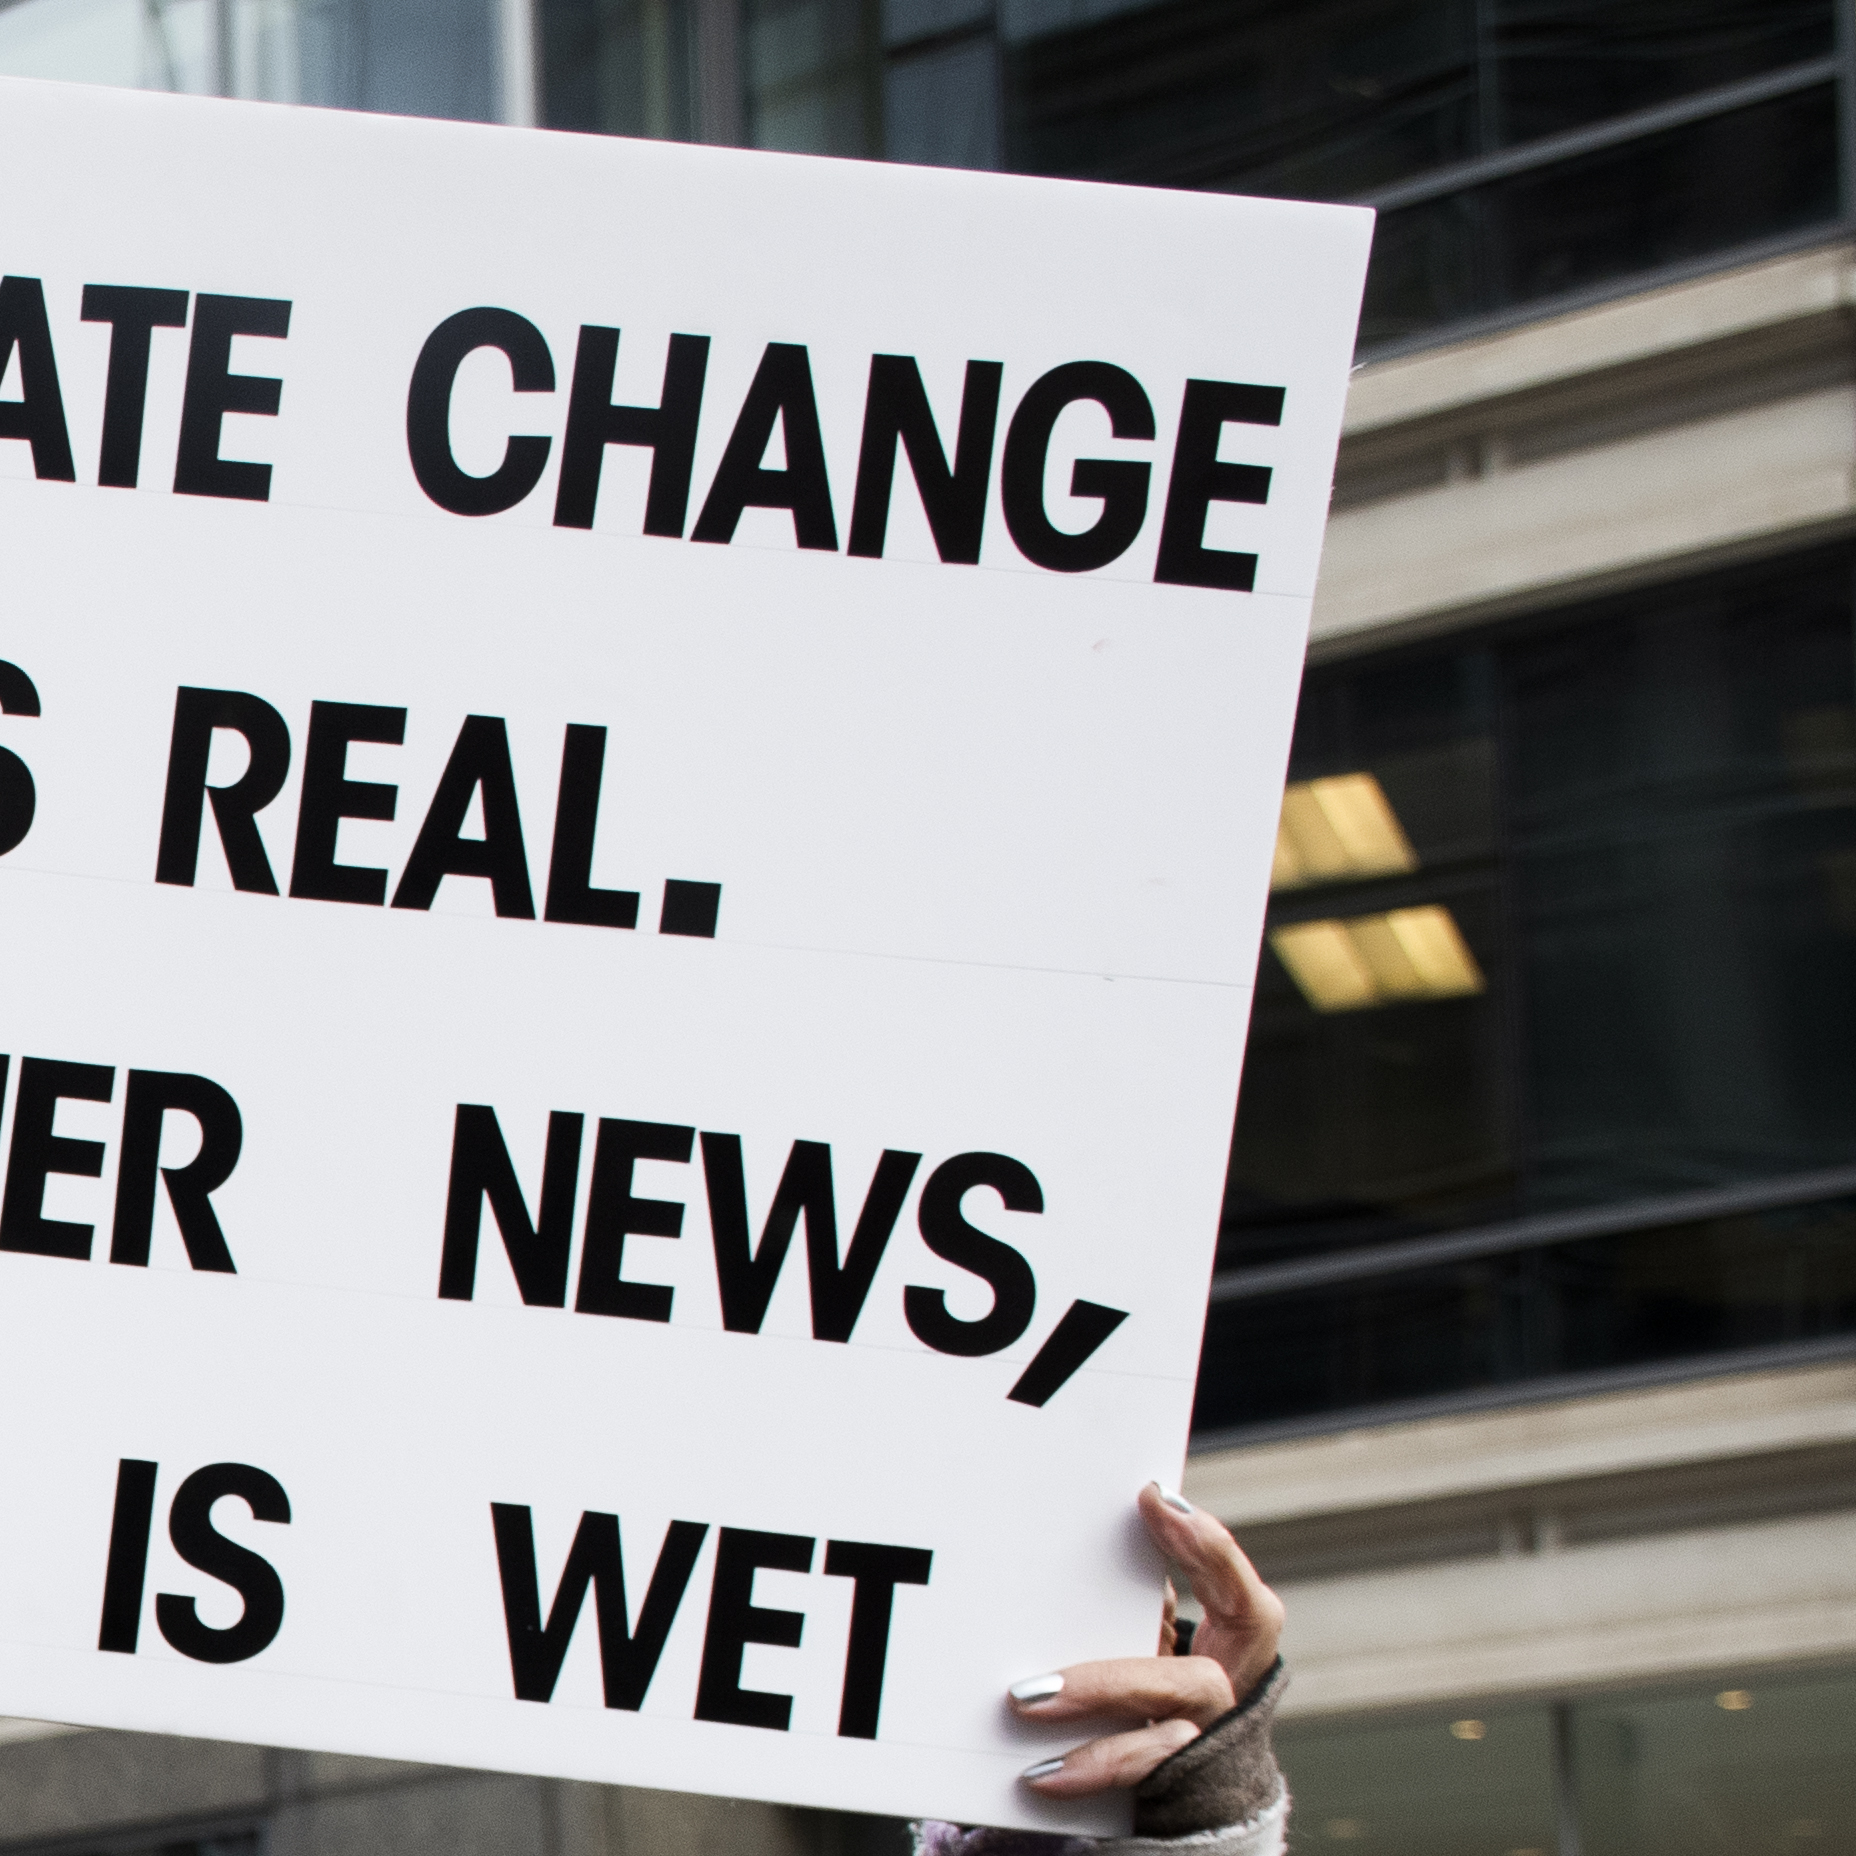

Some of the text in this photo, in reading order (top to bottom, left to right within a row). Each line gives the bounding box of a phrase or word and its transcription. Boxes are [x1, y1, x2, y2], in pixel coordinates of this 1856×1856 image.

[406, 306, 1286, 593] CHANGE
[155, 685, 722, 939] REAL.
[438, 1103, 1130, 1408] NEWS,
[98, 1458, 291, 1664] IS
[490, 1502, 933, 1740] WET
